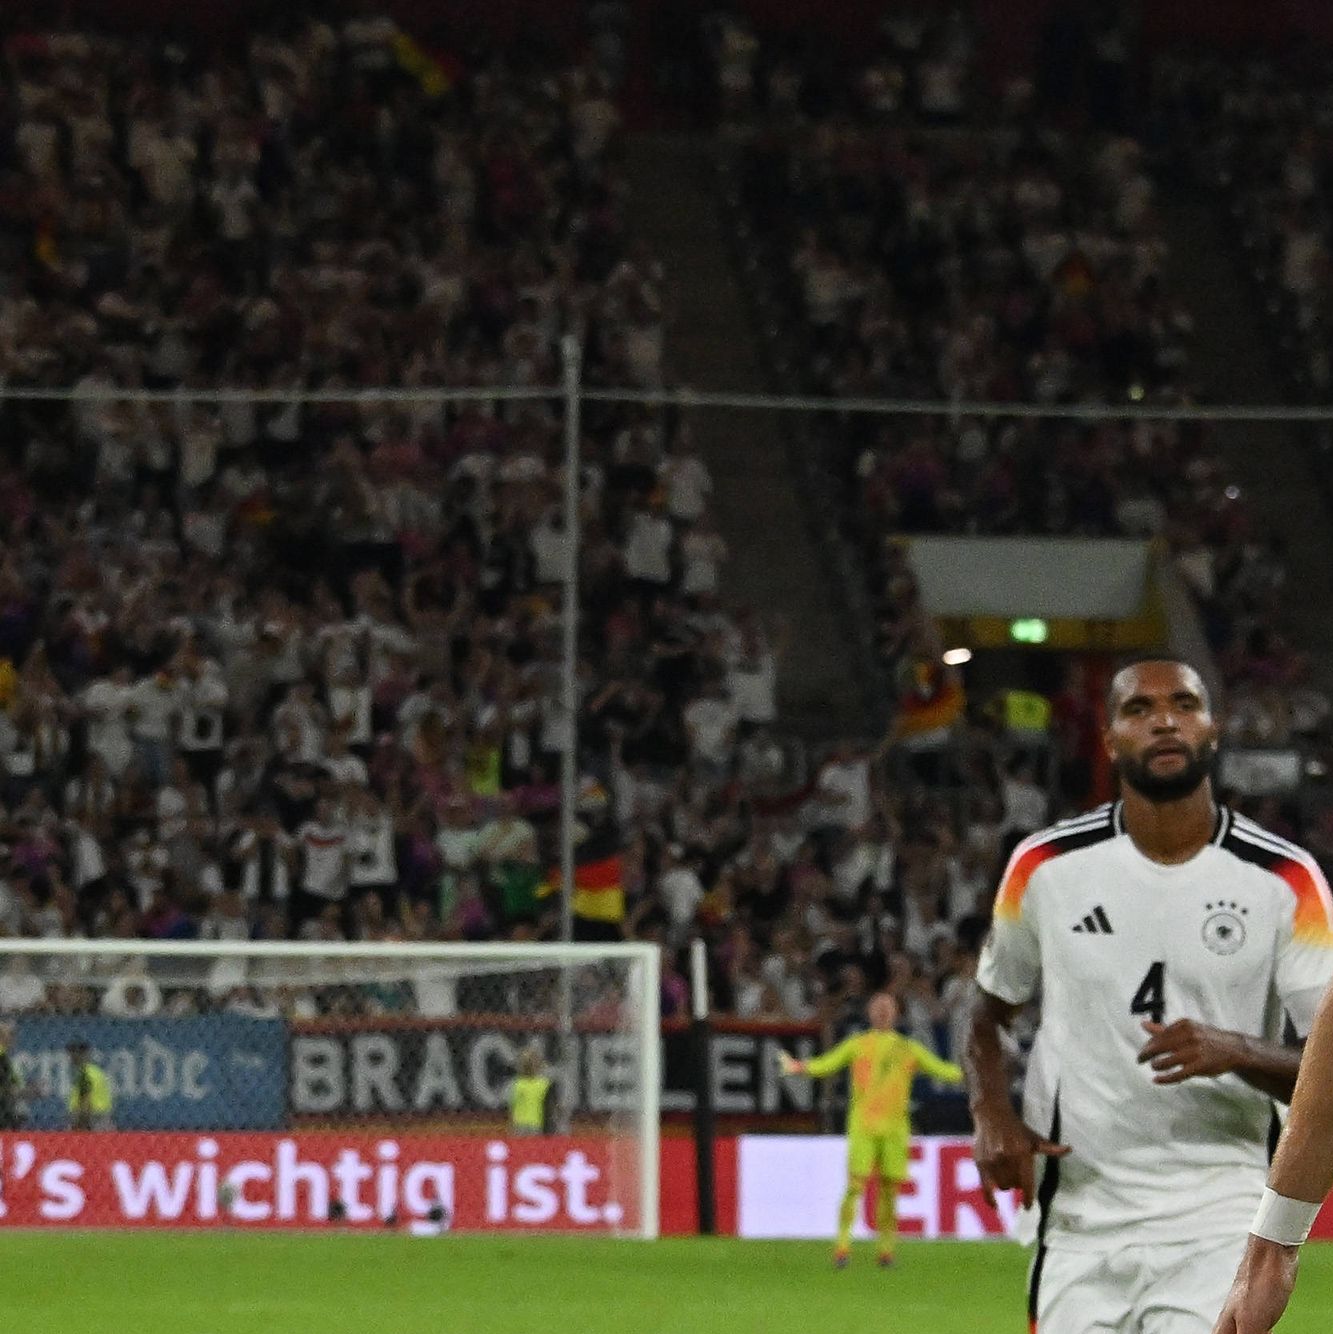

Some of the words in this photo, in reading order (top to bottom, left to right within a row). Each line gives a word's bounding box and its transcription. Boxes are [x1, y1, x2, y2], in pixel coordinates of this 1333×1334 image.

[1130, 961, 1165, 1024] 4
[0, 1139, 86, 1220] 's
[110, 1138, 455, 1236] wichtig
[484, 1140, 625, 1224] ist.
[864, 1145, 1025, 1234] ER
